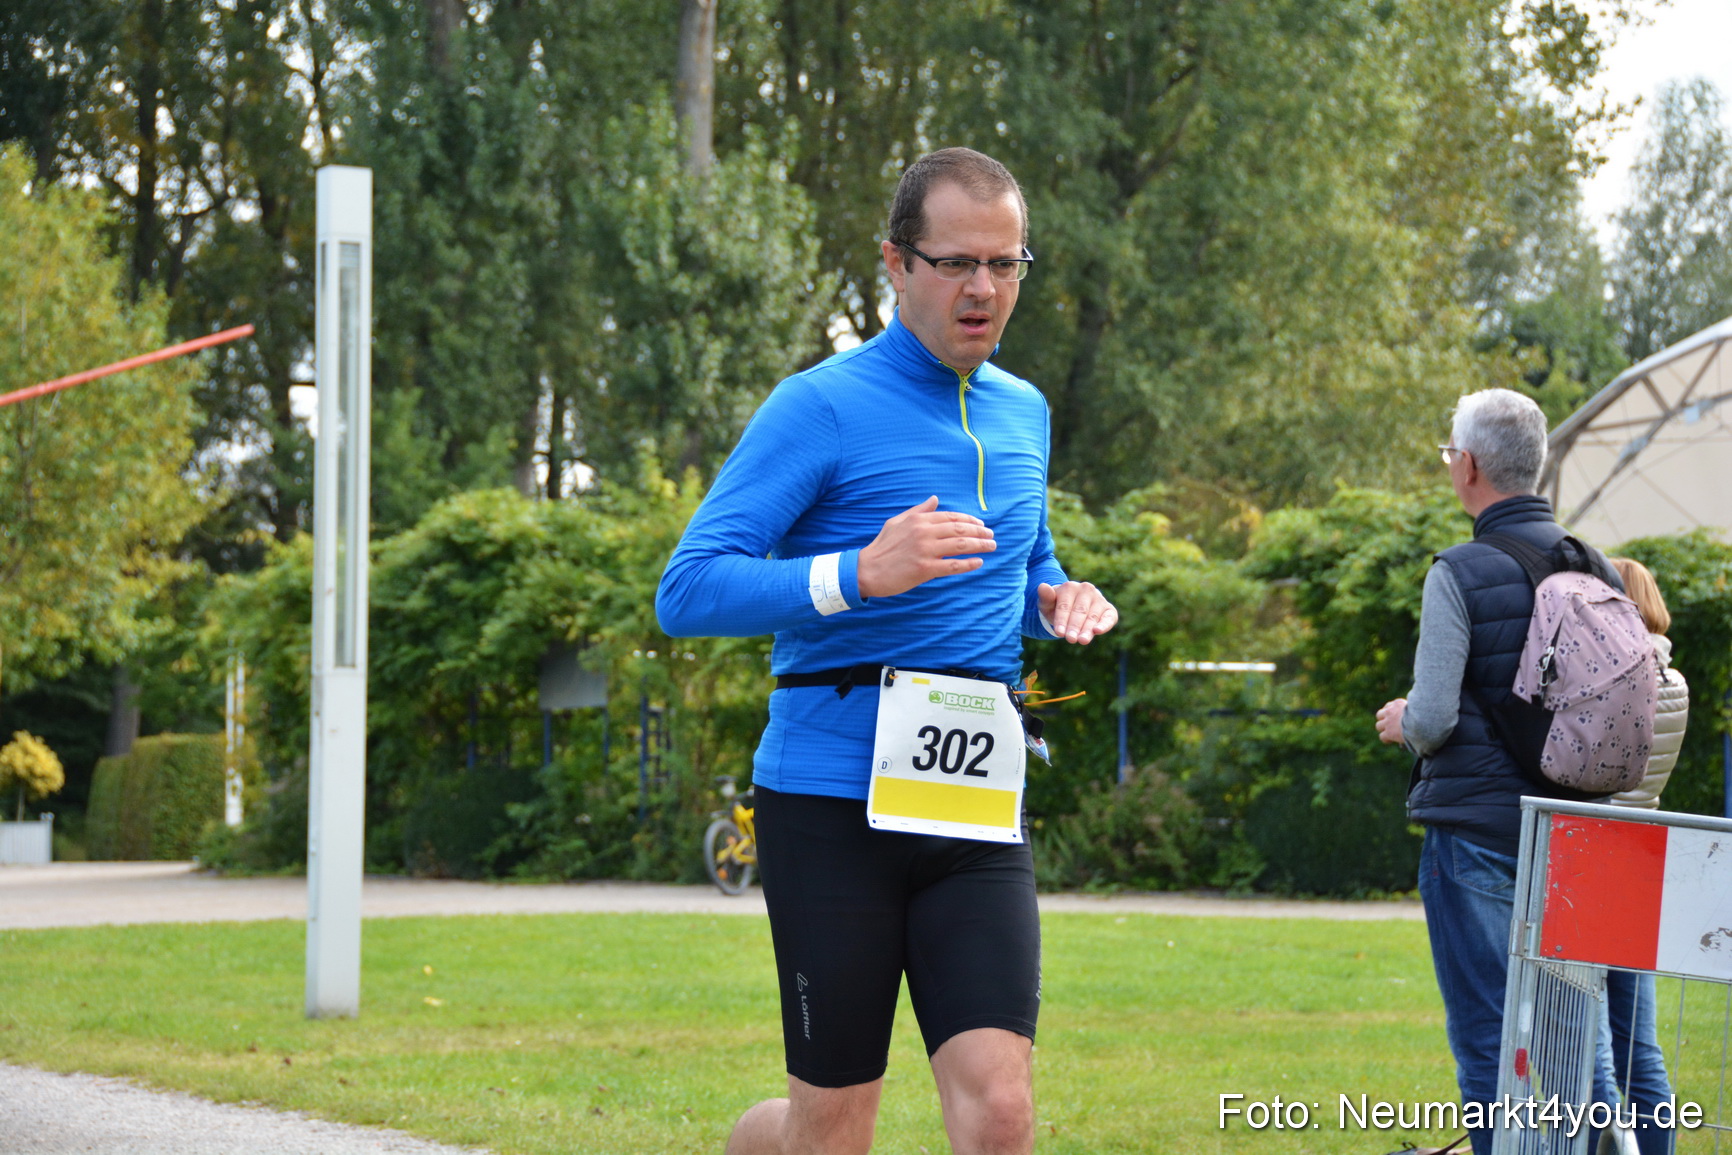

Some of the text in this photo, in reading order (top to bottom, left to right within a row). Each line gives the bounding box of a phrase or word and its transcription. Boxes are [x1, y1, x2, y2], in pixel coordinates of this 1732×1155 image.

[944, 692, 995, 711] BOCK
[912, 725, 995, 778] 302
[881, 760, 888, 770] D
